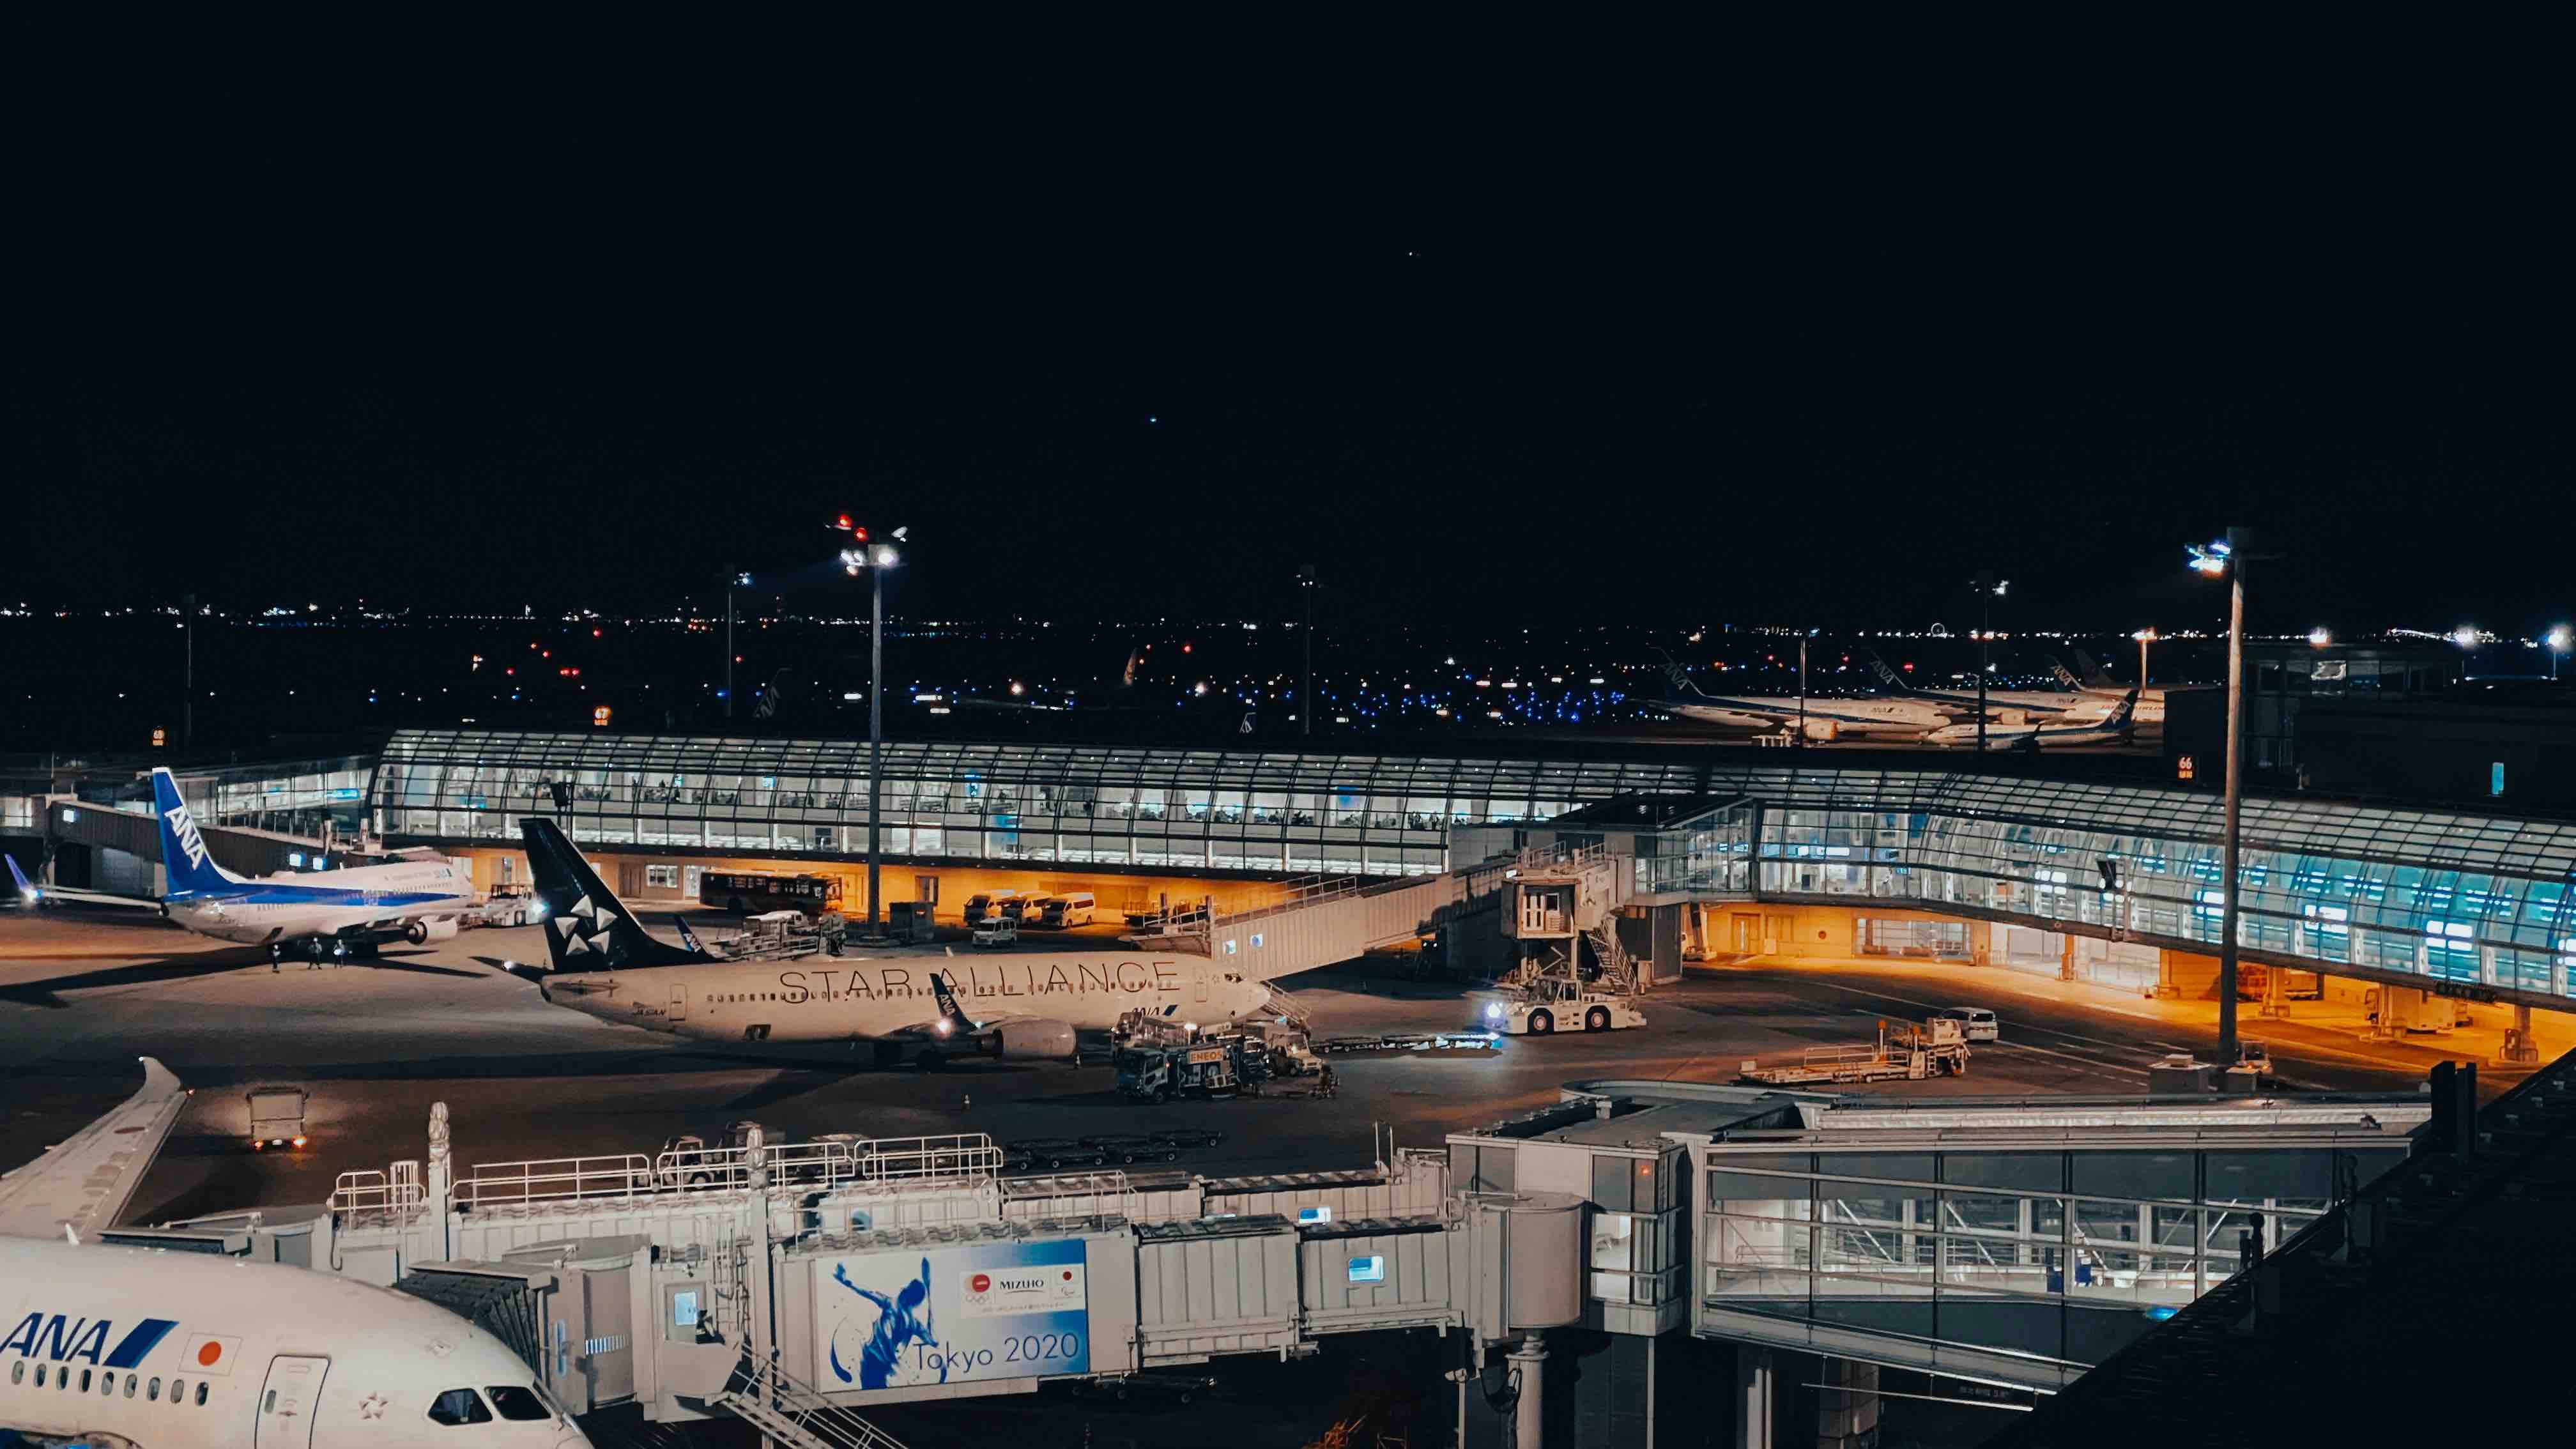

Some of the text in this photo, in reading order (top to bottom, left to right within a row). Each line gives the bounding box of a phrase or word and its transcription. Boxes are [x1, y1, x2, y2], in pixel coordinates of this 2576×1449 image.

[2179, 756, 2192, 770] 66
[164, 805, 204, 870] ANA
[683, 933, 702, 953] ANA
[779, 962, 1181, 1004] STAR ALLIANCE
[1190, 1052, 1222, 1064] ENEOS
[999, 1279, 1045, 1290] MIZUHO
[0, 1312, 112, 1365] ANA
[913, 1333, 1078, 1373] Tokyo 2020
